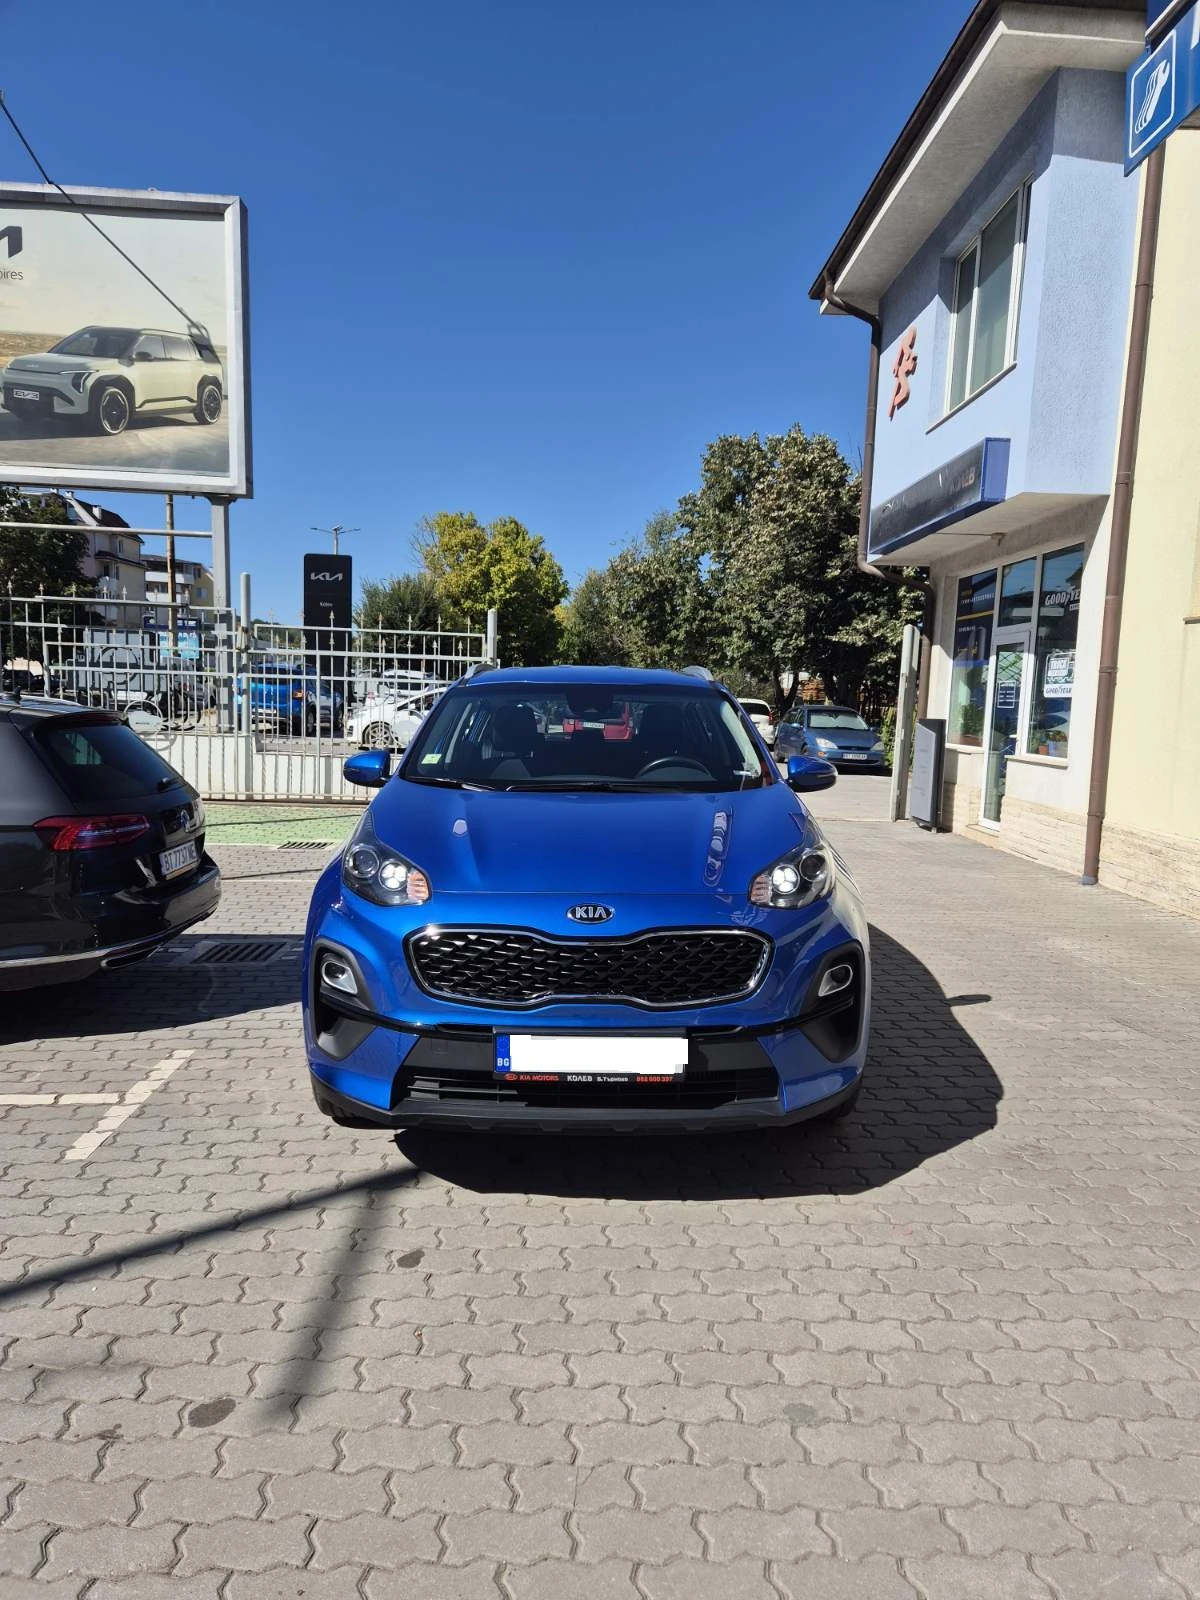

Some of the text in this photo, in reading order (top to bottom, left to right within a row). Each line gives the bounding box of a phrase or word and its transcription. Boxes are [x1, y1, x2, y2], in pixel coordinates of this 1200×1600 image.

[311, 572, 343, 581] KIA
[1045, 585, 1081, 606] GOODYE
[575, 906, 607, 919] KIA
[497, 1057, 510, 1067] BG
